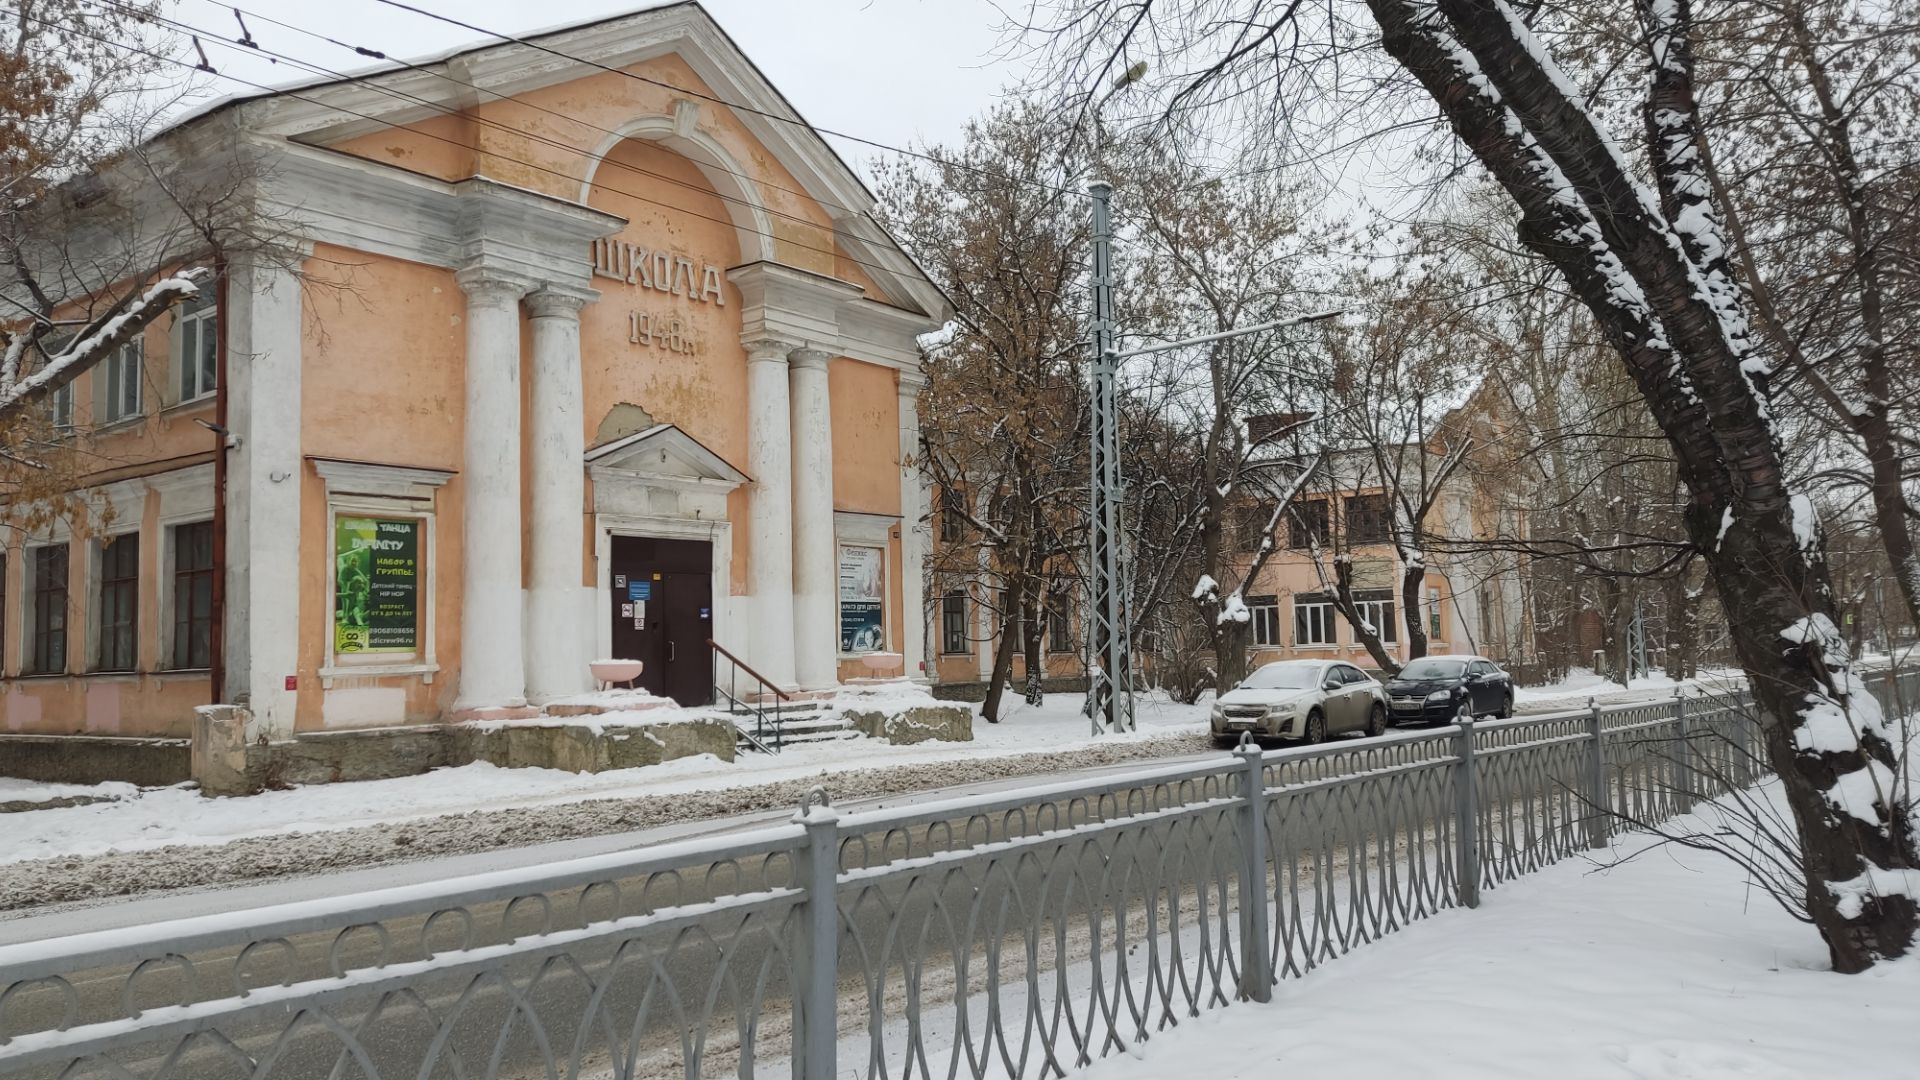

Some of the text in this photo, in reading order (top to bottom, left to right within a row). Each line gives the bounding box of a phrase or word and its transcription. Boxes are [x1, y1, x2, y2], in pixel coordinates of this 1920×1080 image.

[594, 238, 725, 307] ШКОЛА
[380, 523, 411, 534] ТАНЦА
[376, 558, 405, 566] НАБОР
